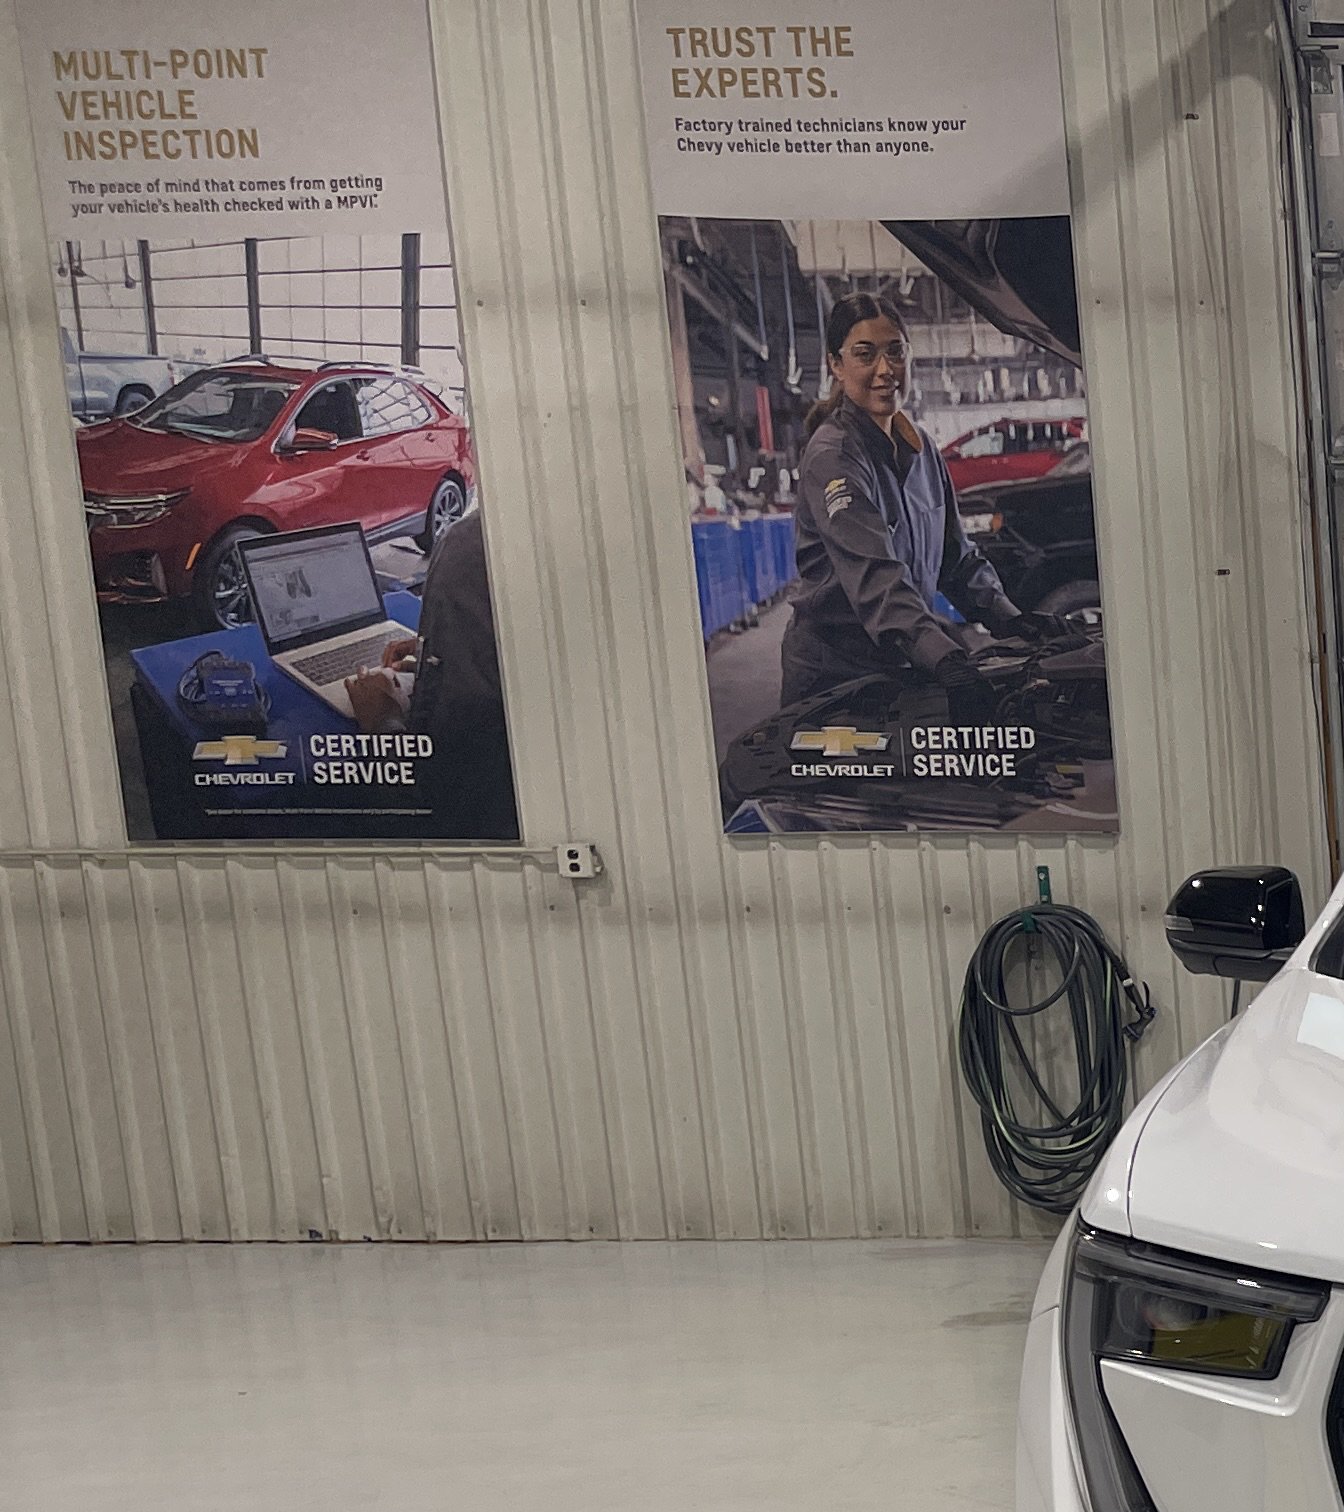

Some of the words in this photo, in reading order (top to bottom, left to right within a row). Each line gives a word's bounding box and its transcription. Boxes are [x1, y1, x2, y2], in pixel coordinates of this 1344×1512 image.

[666, 26, 776, 58] TRUST
[786, 25, 854, 57] THE
[53, 47, 268, 81] MULTI-POINT
[672, 67, 838, 98] EXPERTS.
[58, 89, 198, 121] VEHICLE
[675, 117, 734, 136] Factory
[738, 118, 792, 133] trained
[796, 118, 884, 134] technicians
[888, 117, 928, 132] know
[932, 118, 966, 134] your
[64, 128, 260, 162] INSPECTION
[677, 137, 723, 156] Chevy
[728, 138, 780, 154] vehicle
[785, 138, 832, 154] better
[836, 138, 871, 154] than
[876, 139, 934, 156] anyone.
[68, 180, 95, 194] The
[100, 181, 141, 196] peace
[147, 179, 161, 193] of
[165, 179, 200, 193] mind
[205, 178, 235, 192] that
[239, 179, 286, 192] comes
[290, 176, 325, 191] from
[329, 175, 383, 193] getting
[71, 202, 103, 218] your
[108, 199, 170, 214] vehicle's
[174, 198, 220, 214] health
[224, 197, 284, 212] checked
[288, 196, 320, 211] with
[325, 200, 333, 210] a
[309, 734, 434, 759] CERTIFIED
[910, 727, 1036, 750] CERTIFIED
[314, 762, 415, 786] SERVICE
[791, 764, 895, 777] CHEVROLET
[913, 754, 1017, 777] SERVICE
[194, 772, 295, 786] CHEVROLET
